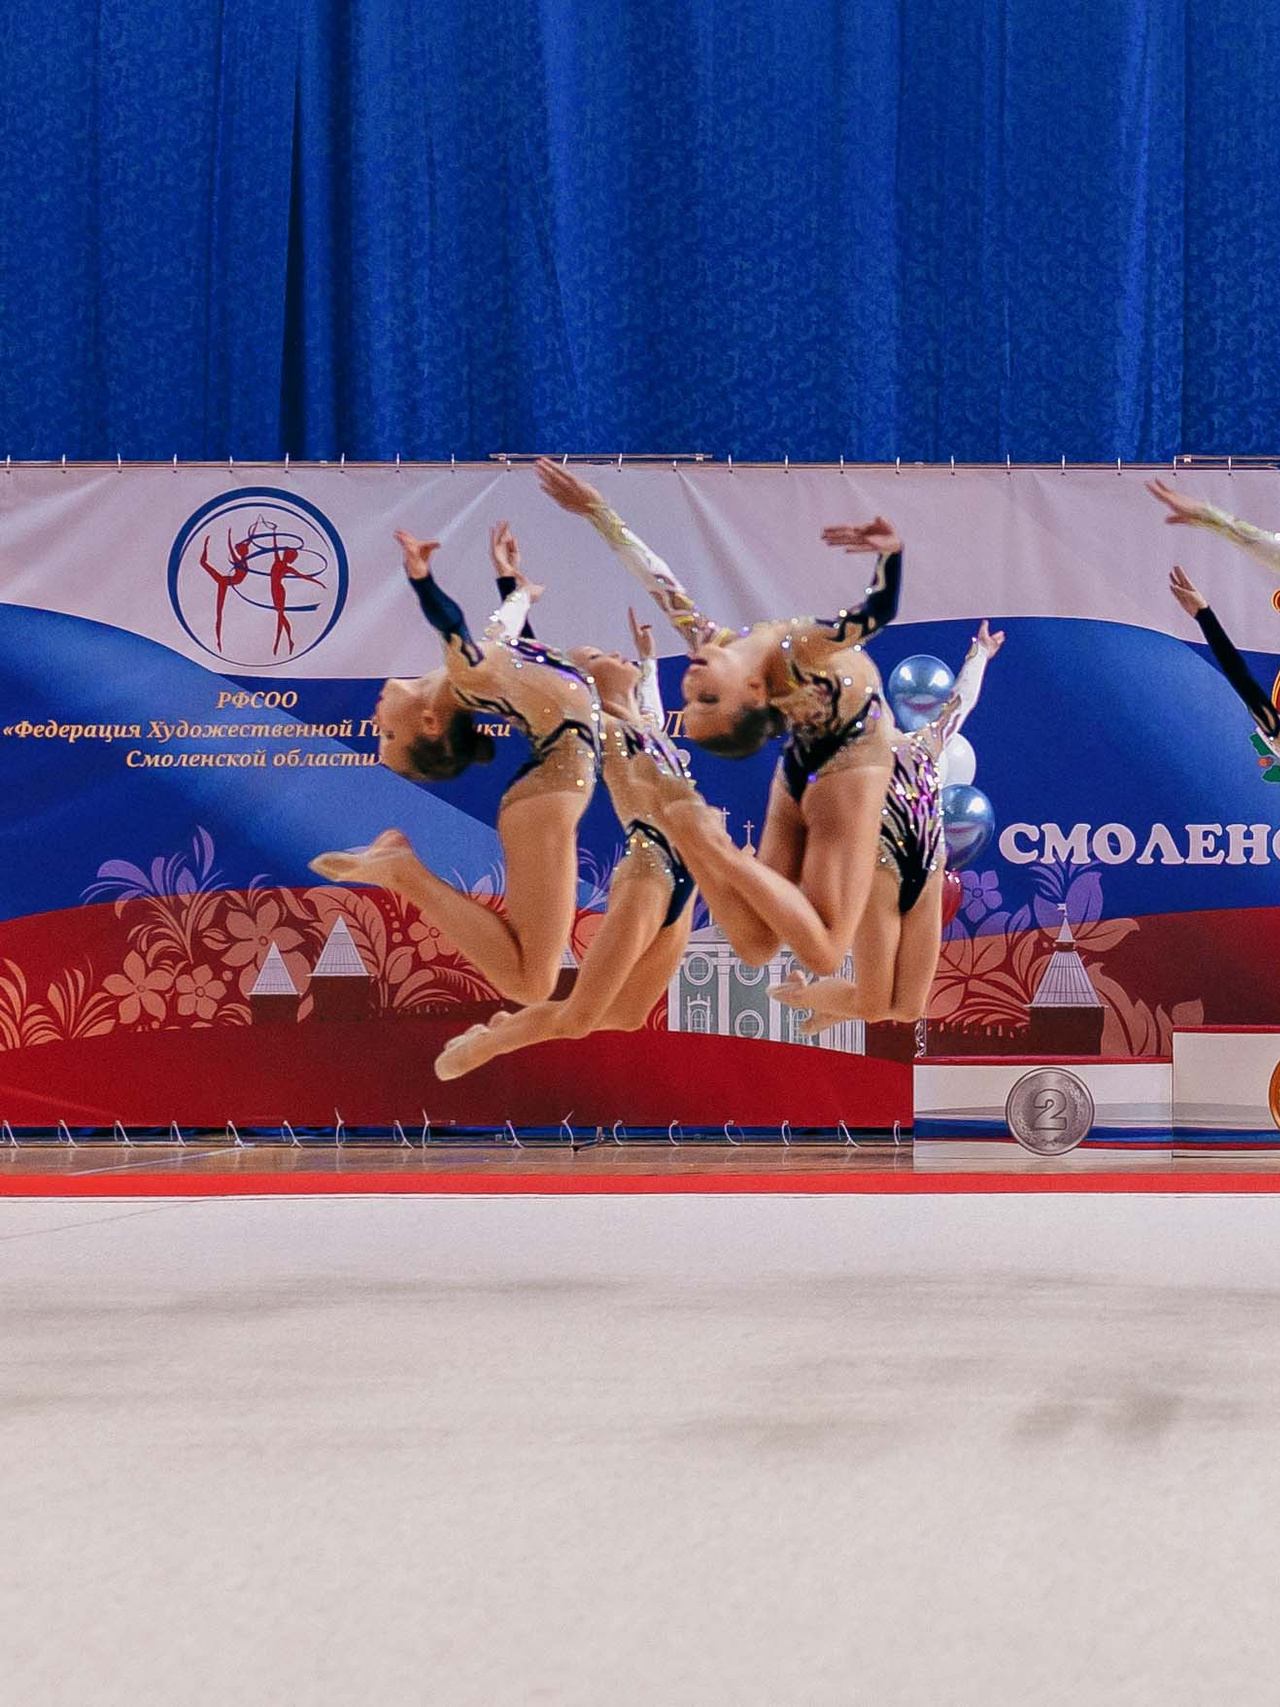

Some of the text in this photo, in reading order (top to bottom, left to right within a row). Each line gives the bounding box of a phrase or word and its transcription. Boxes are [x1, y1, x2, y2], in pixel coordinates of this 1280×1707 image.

[216, 691, 298, 709] РФСОО
[3, 719, 141, 743] «Федерация
[147, 719, 353, 743] Художественной
[126, 748, 266, 768] Смоленской
[1032, 1088, 1067, 1131] 2
